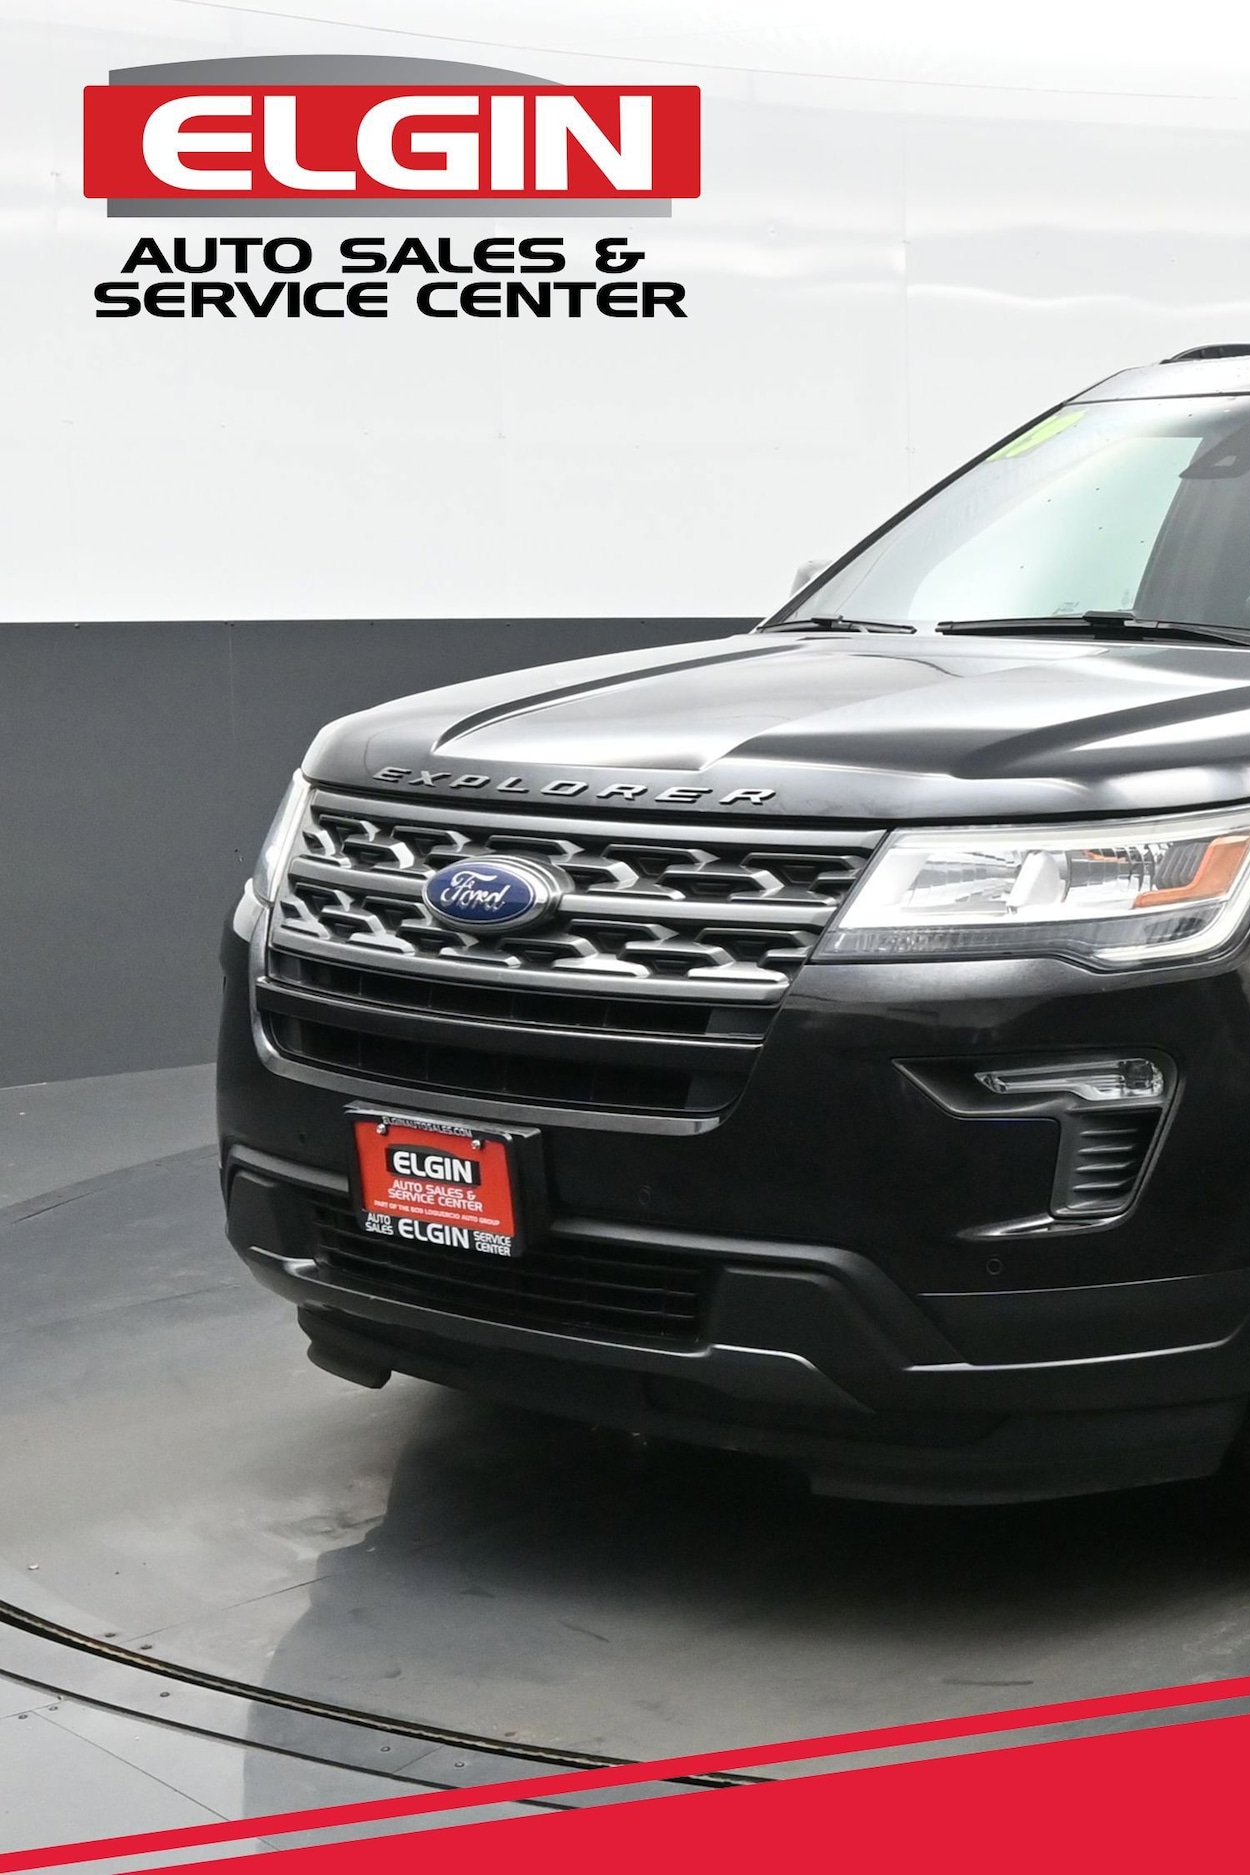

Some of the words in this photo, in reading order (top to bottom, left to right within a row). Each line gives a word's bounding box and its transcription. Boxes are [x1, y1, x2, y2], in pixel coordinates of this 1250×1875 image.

[372, 766, 777, 805] EXPLORER
[440, 870, 511, 911] Ford
[393, 1151, 473, 1184] ELGIN
[387, 1188, 435, 1205] SERVICE
[438, 1196, 484, 1213] CENTER
[392, 1180, 423, 1193] AUTO
[425, 1184, 464, 1200] SALES
[466, 1190, 476, 1201] &
[365, 1222, 394, 1236] SALES
[367, 1212, 391, 1226] AUTO
[398, 1218, 470, 1249] ELGIN
[473, 1230, 511, 1247] SERVICE
[475, 1242, 511, 1257] CENTER
